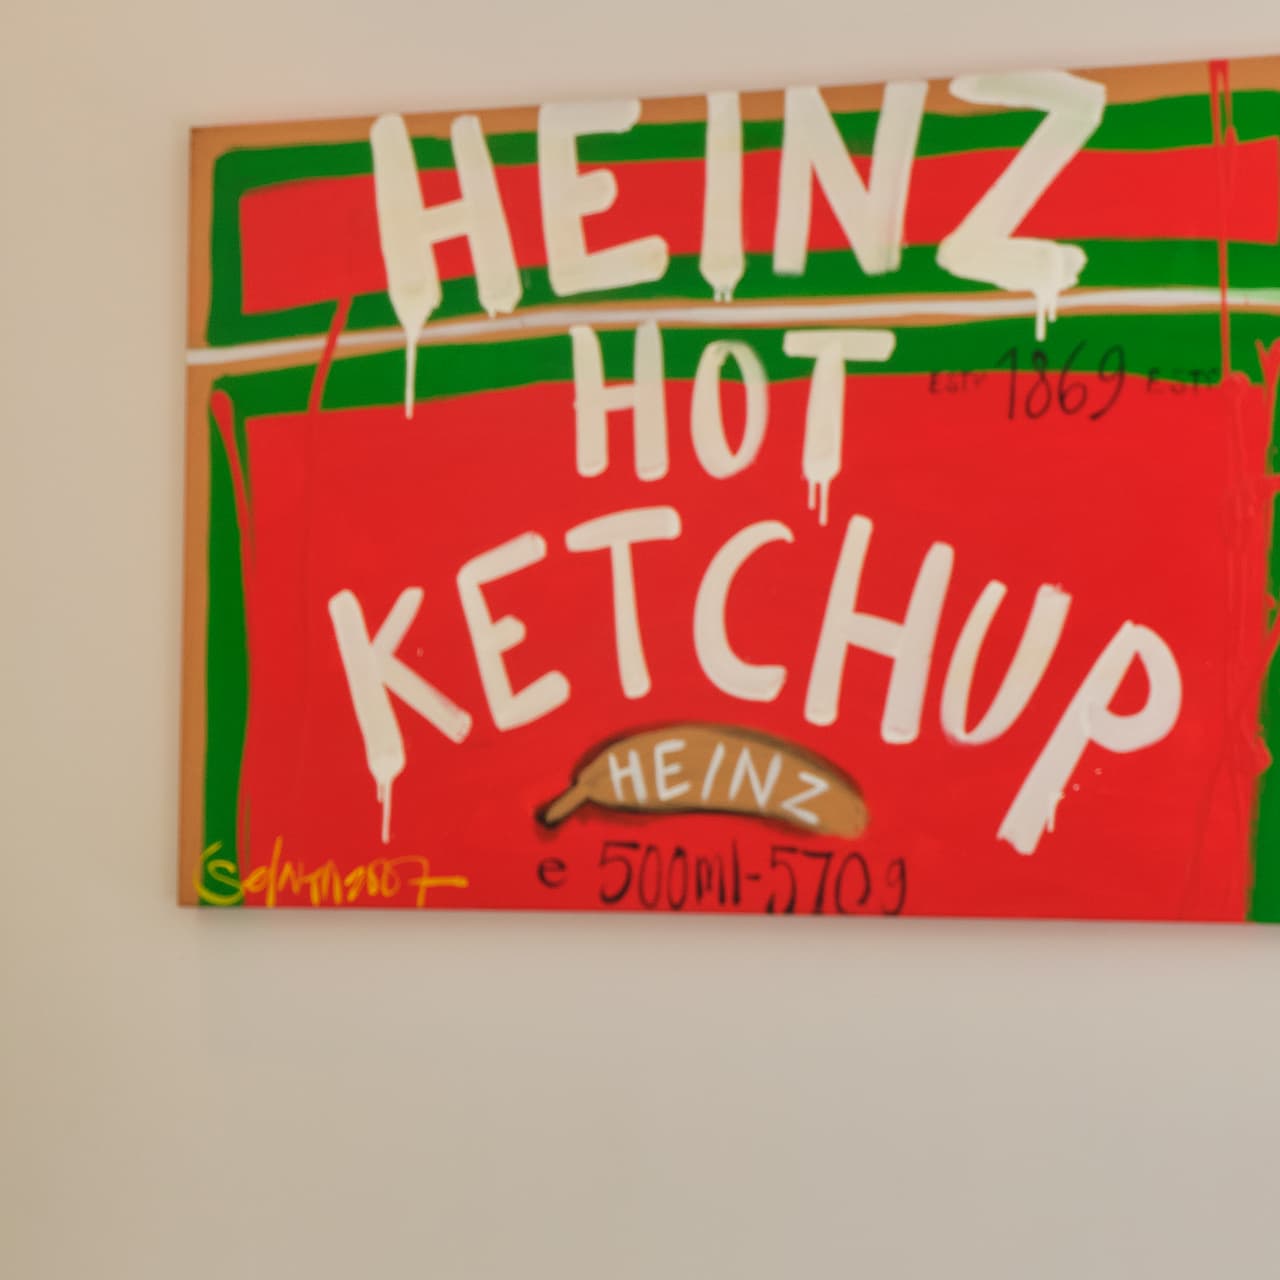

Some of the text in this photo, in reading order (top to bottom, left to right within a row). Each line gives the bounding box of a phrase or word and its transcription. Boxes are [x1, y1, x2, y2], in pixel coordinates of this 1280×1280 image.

[370, 68, 1107, 350] HEINZ
[570, 318, 897, 498] HOT
[993, 339, 1127, 421] 1869
[328, 505, 1182, 854] KETCHUP
[607, 738, 831, 827] HEINZ
